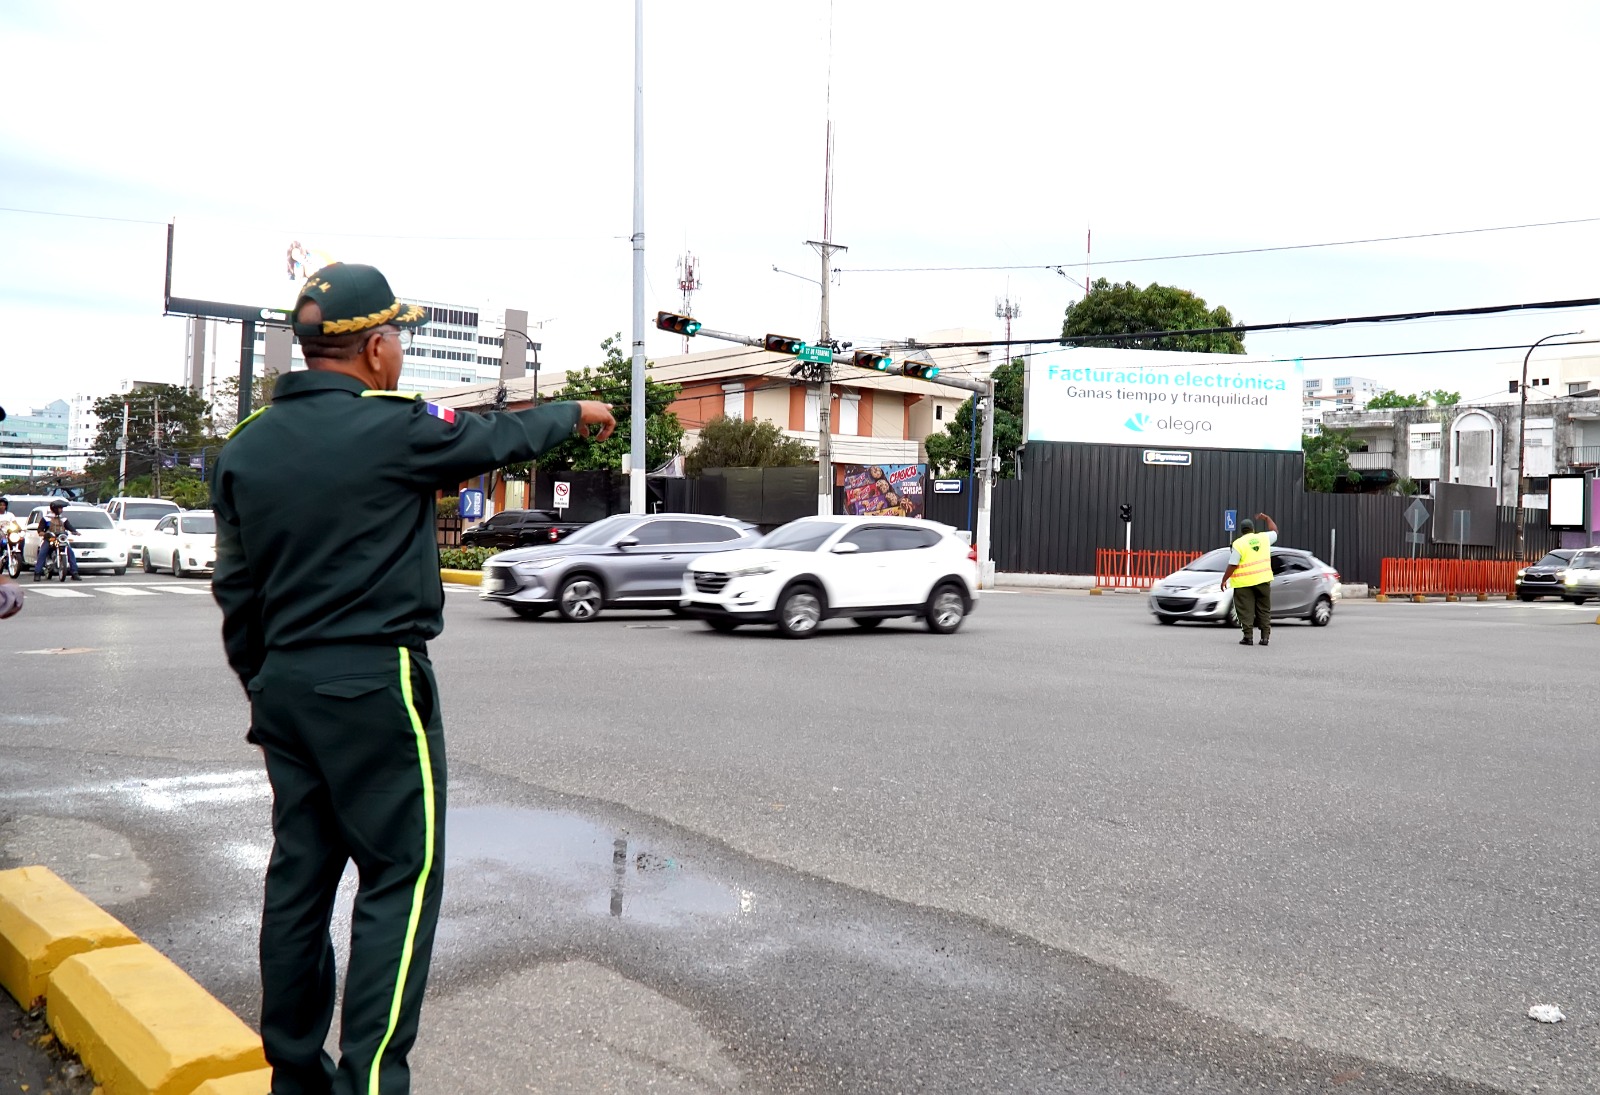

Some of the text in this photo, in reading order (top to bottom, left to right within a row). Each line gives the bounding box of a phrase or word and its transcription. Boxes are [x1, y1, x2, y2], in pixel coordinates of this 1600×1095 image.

[1047, 364, 1286, 390] Facturación electrónica
[1067, 385, 1268, 407] Ganas tiempo y tranquilidad
[1157, 415, 1212, 435] alegra
